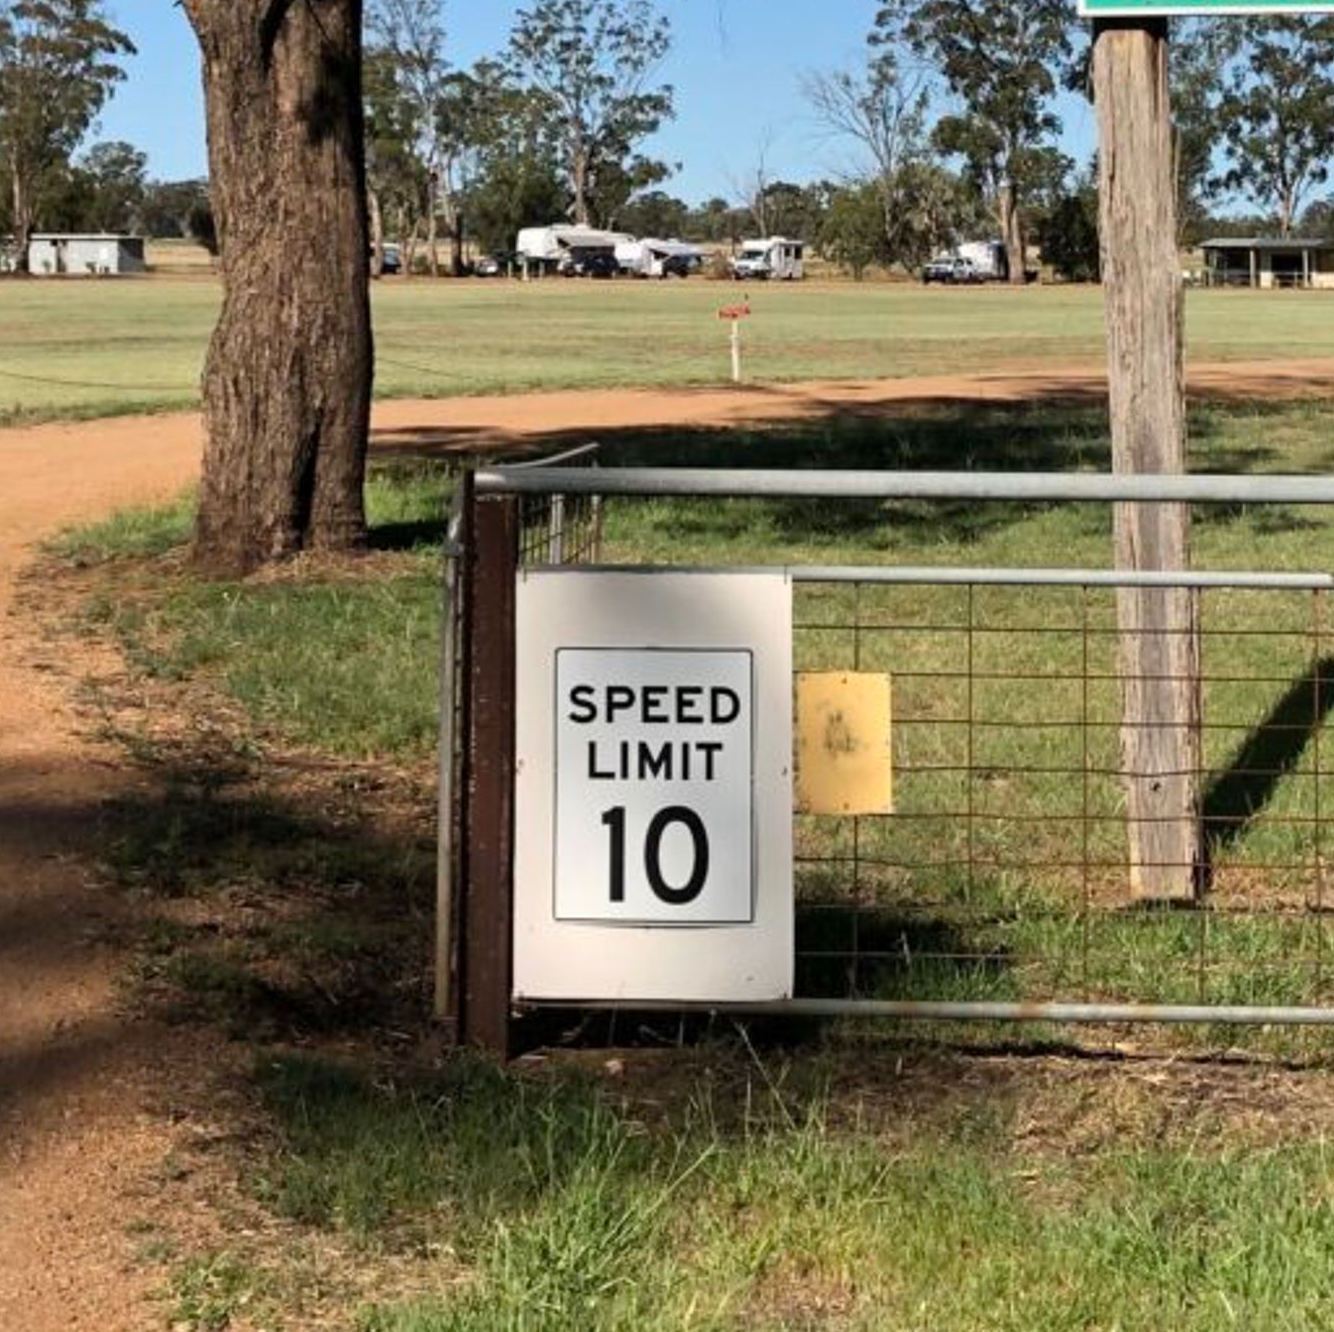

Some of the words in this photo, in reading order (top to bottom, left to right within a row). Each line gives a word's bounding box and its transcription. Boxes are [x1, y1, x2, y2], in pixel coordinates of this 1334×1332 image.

[569, 685, 741, 724] SPEED
[587, 741, 723, 781] LIMIT
[601, 805, 710, 905] 10
